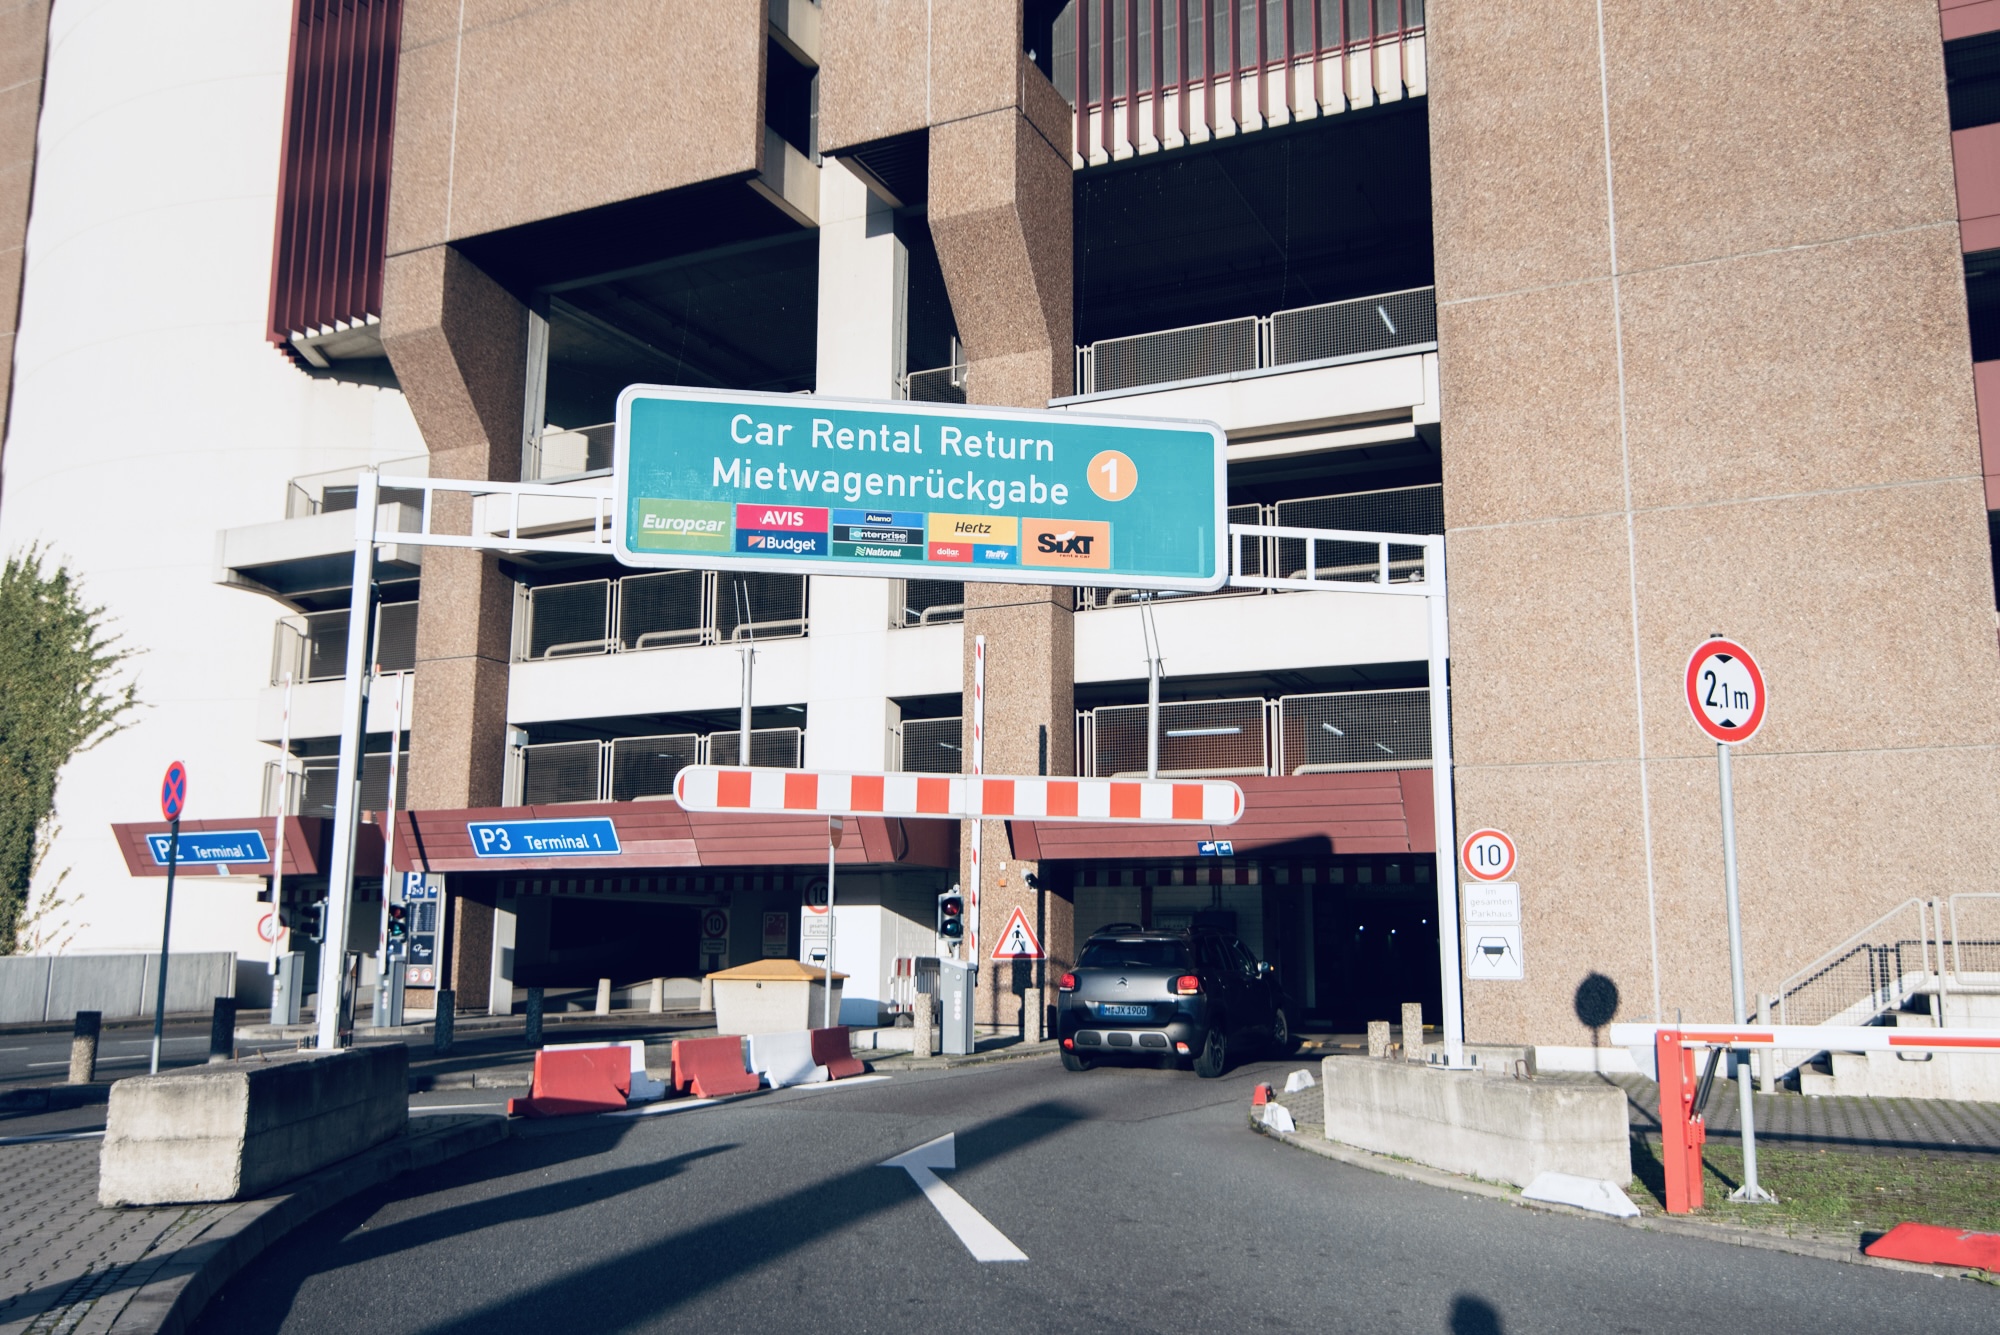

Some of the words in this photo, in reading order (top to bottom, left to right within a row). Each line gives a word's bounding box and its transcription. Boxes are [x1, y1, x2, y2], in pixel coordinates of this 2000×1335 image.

[730, 413, 793, 446] Car
[812, 418, 922, 454] Rental
[940, 425, 1054, 461] Return
[712, 456, 1069, 510] Mietwagenrückgabe
[1100, 458, 1118, 493] 1
[642, 513, 726, 536] Europcar
[761, 510, 804, 527] AVIS
[866, 514, 892, 523] Alamo
[853, 530, 906, 540] enterprise
[954, 521, 992, 534] Hertz
[766, 536, 816, 554] Budget
[865, 547, 902, 557] National
[478, 827, 512, 852] P3
[523, 833, 590, 850] Terminal
[593, 833, 602, 848] 1
[192, 843, 245, 859] Terminal
[246, 843, 255, 857] 1
[1476, 844, 1502, 866] 10
[406, 871, 422, 895] P
[812, 886, 829, 904] 10
[1470, 898, 1513, 908] gesamten
[1471, 909, 1513, 918] Parkhaus
[709, 917, 721, 931] 10
[1127, 1007, 1147, 1016] 1906
